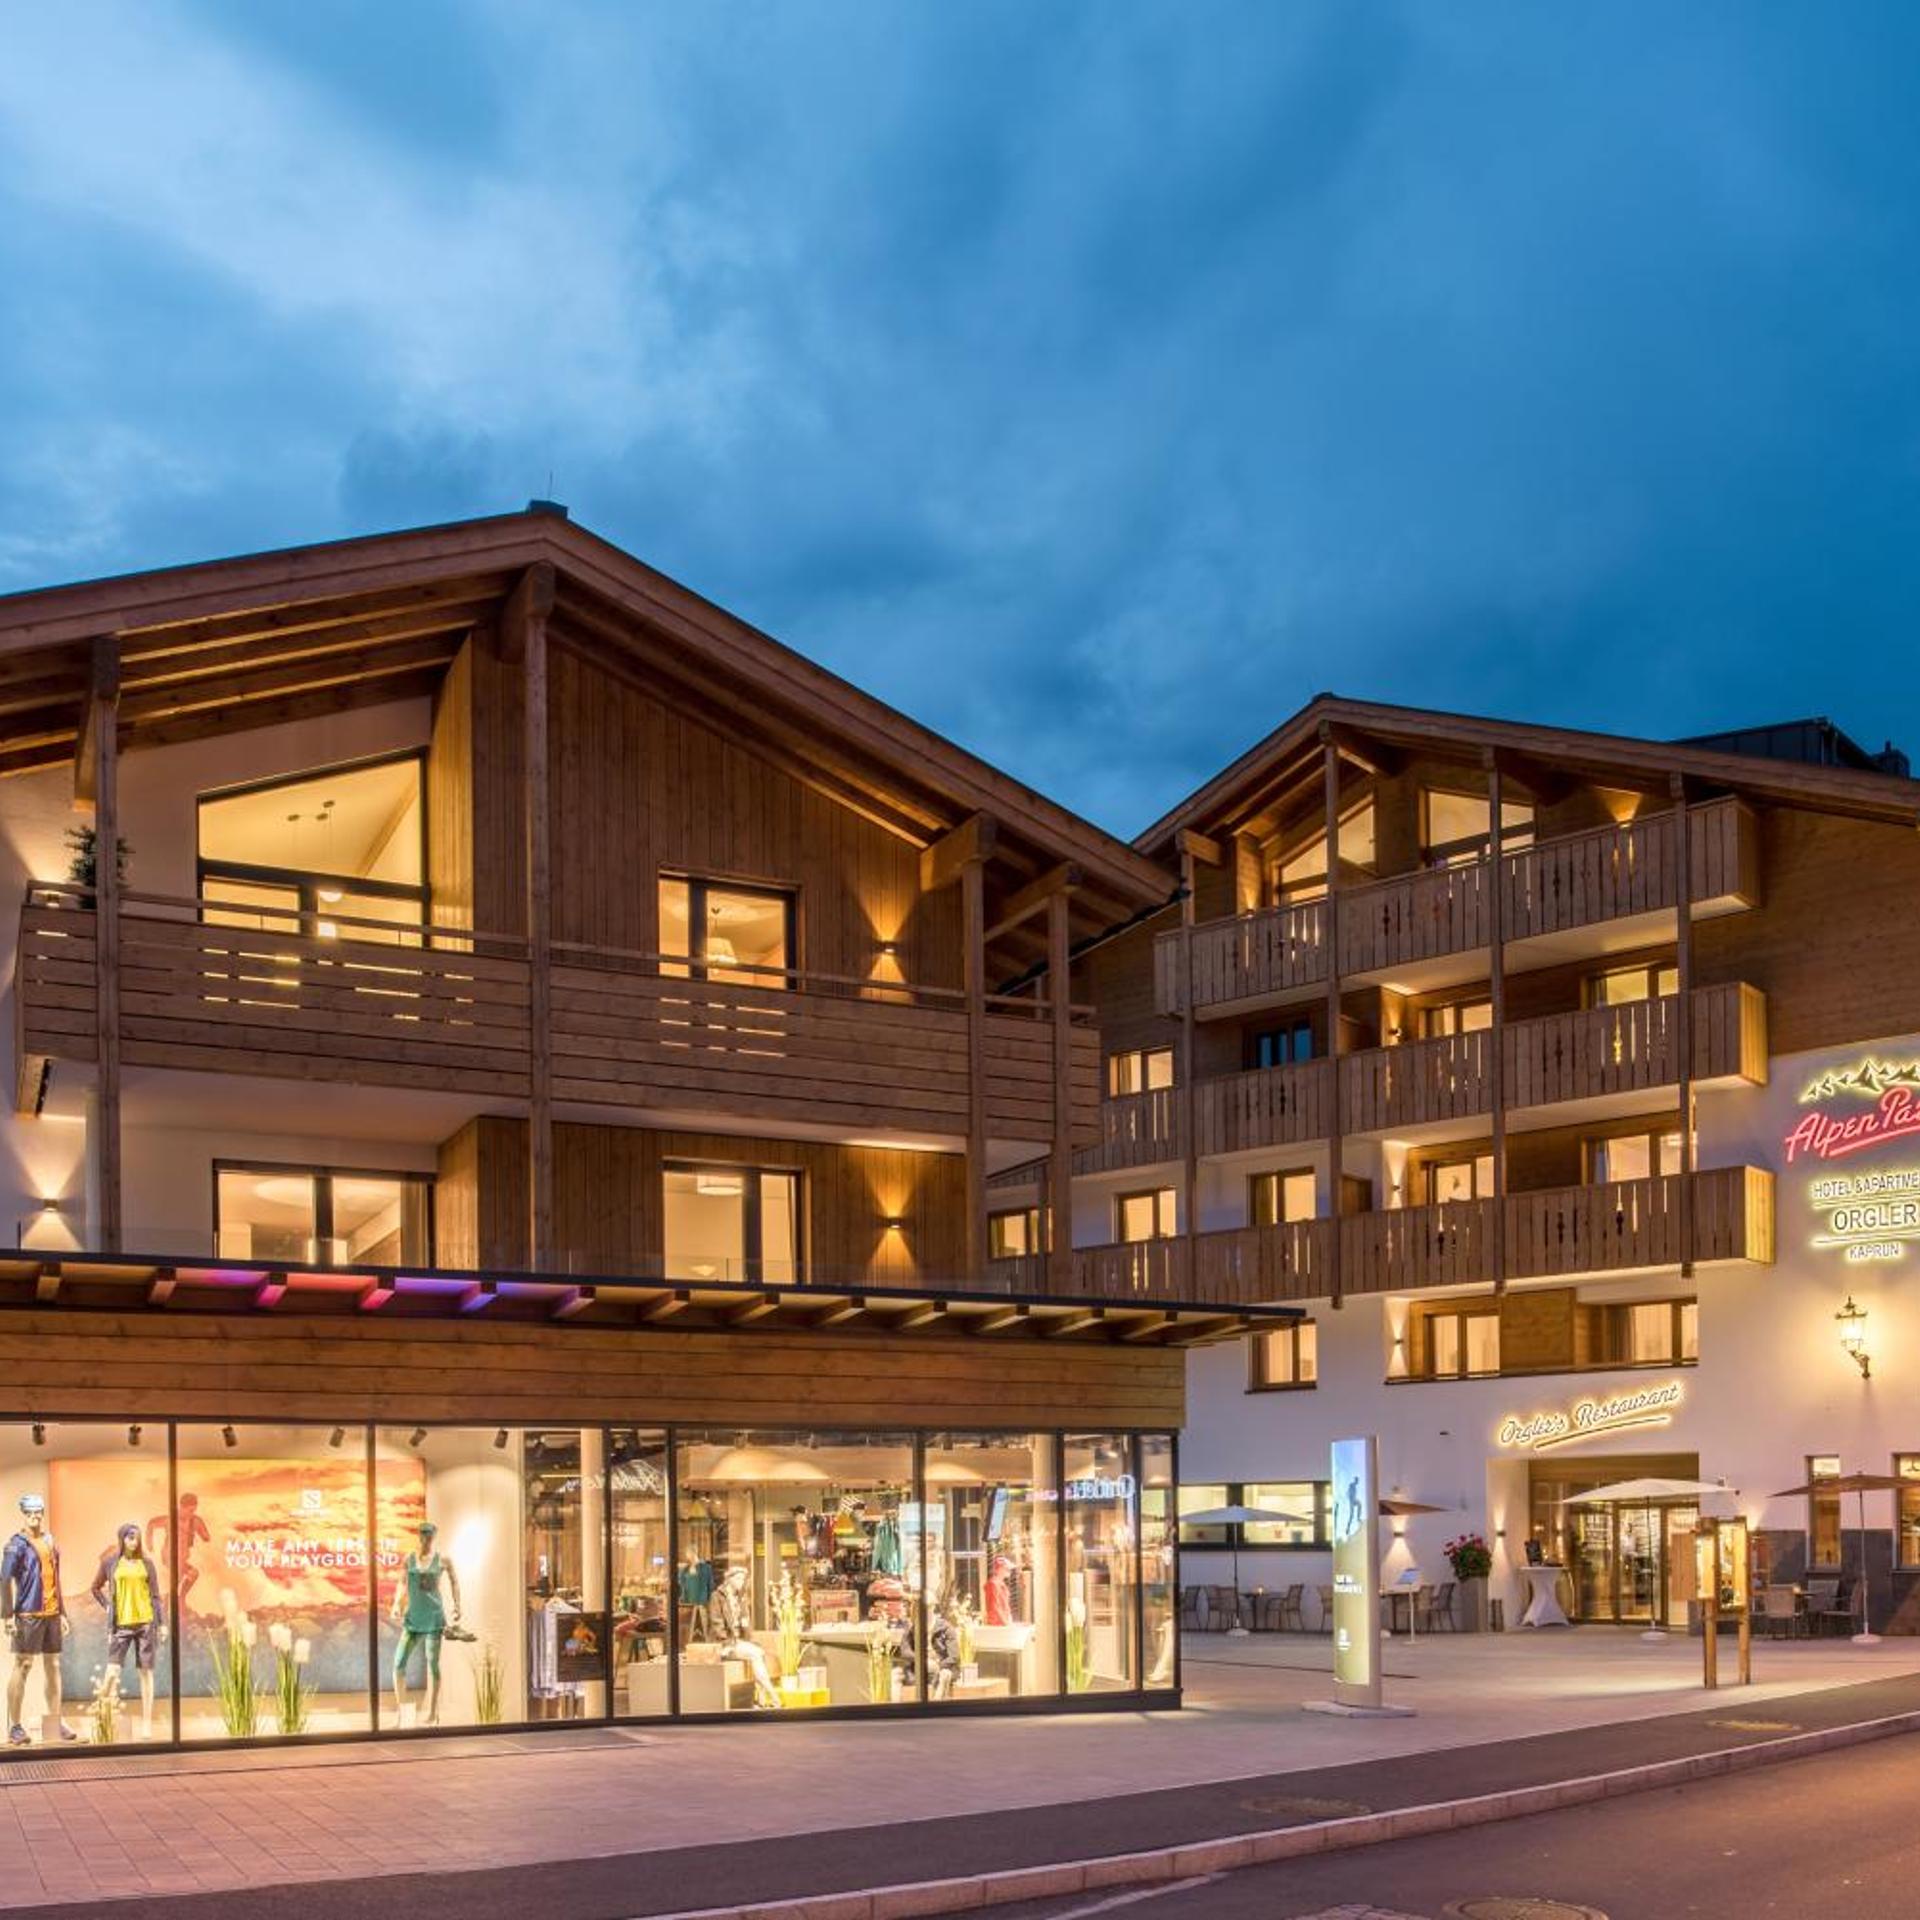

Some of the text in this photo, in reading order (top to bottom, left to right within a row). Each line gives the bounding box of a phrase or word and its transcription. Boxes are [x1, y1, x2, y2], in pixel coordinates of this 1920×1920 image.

[1784, 1111, 1879, 1163] Alpen
[1813, 1181, 1852, 1198] HOTEL
[1834, 1203, 1917, 1231] ORGLER
[1849, 1242, 1900, 1259] KAPRUN
[1500, 1384, 1681, 1443] Orgler's Restaurant
[226, 1538, 275, 1553] MAKE
[282, 1537, 320, 1553] ANY
[226, 1554, 274, 1569] YOUR
